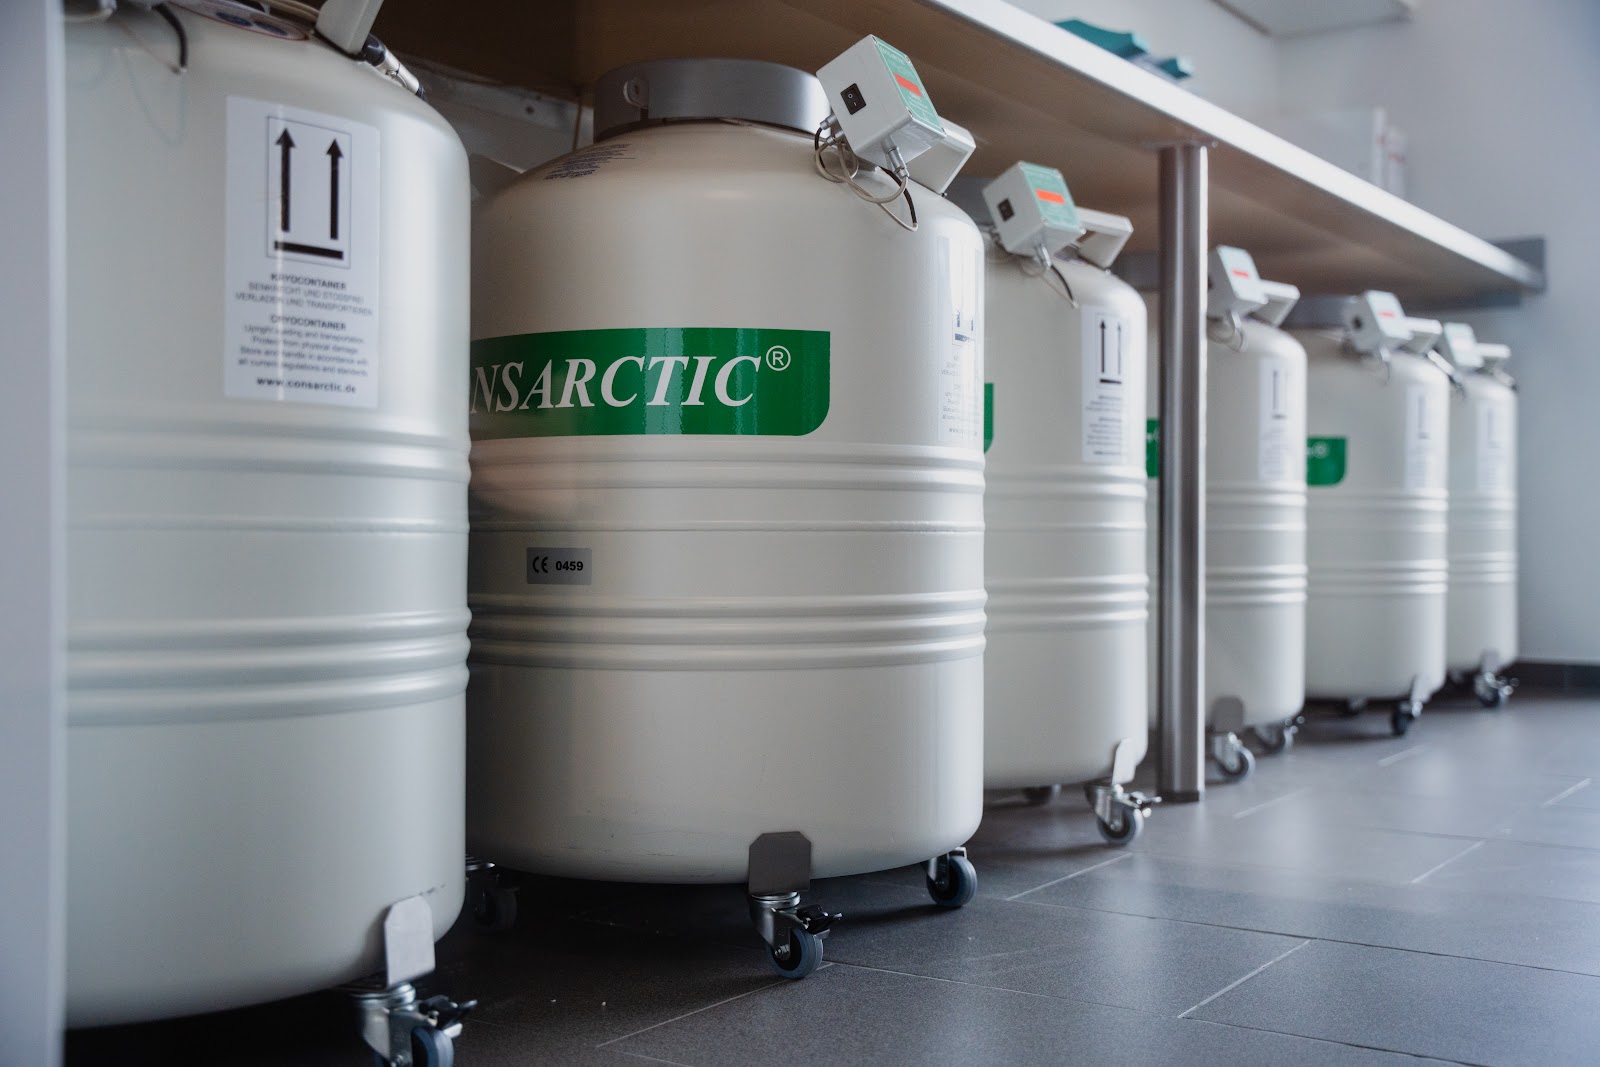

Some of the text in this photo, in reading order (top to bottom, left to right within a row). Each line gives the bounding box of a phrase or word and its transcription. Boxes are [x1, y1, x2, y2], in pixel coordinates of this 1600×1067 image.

[271, 273, 347, 290] KRYOCONTAINER
[257, 376, 356, 394] www.consarctic.de
[555, 560, 584, 571] 0459
